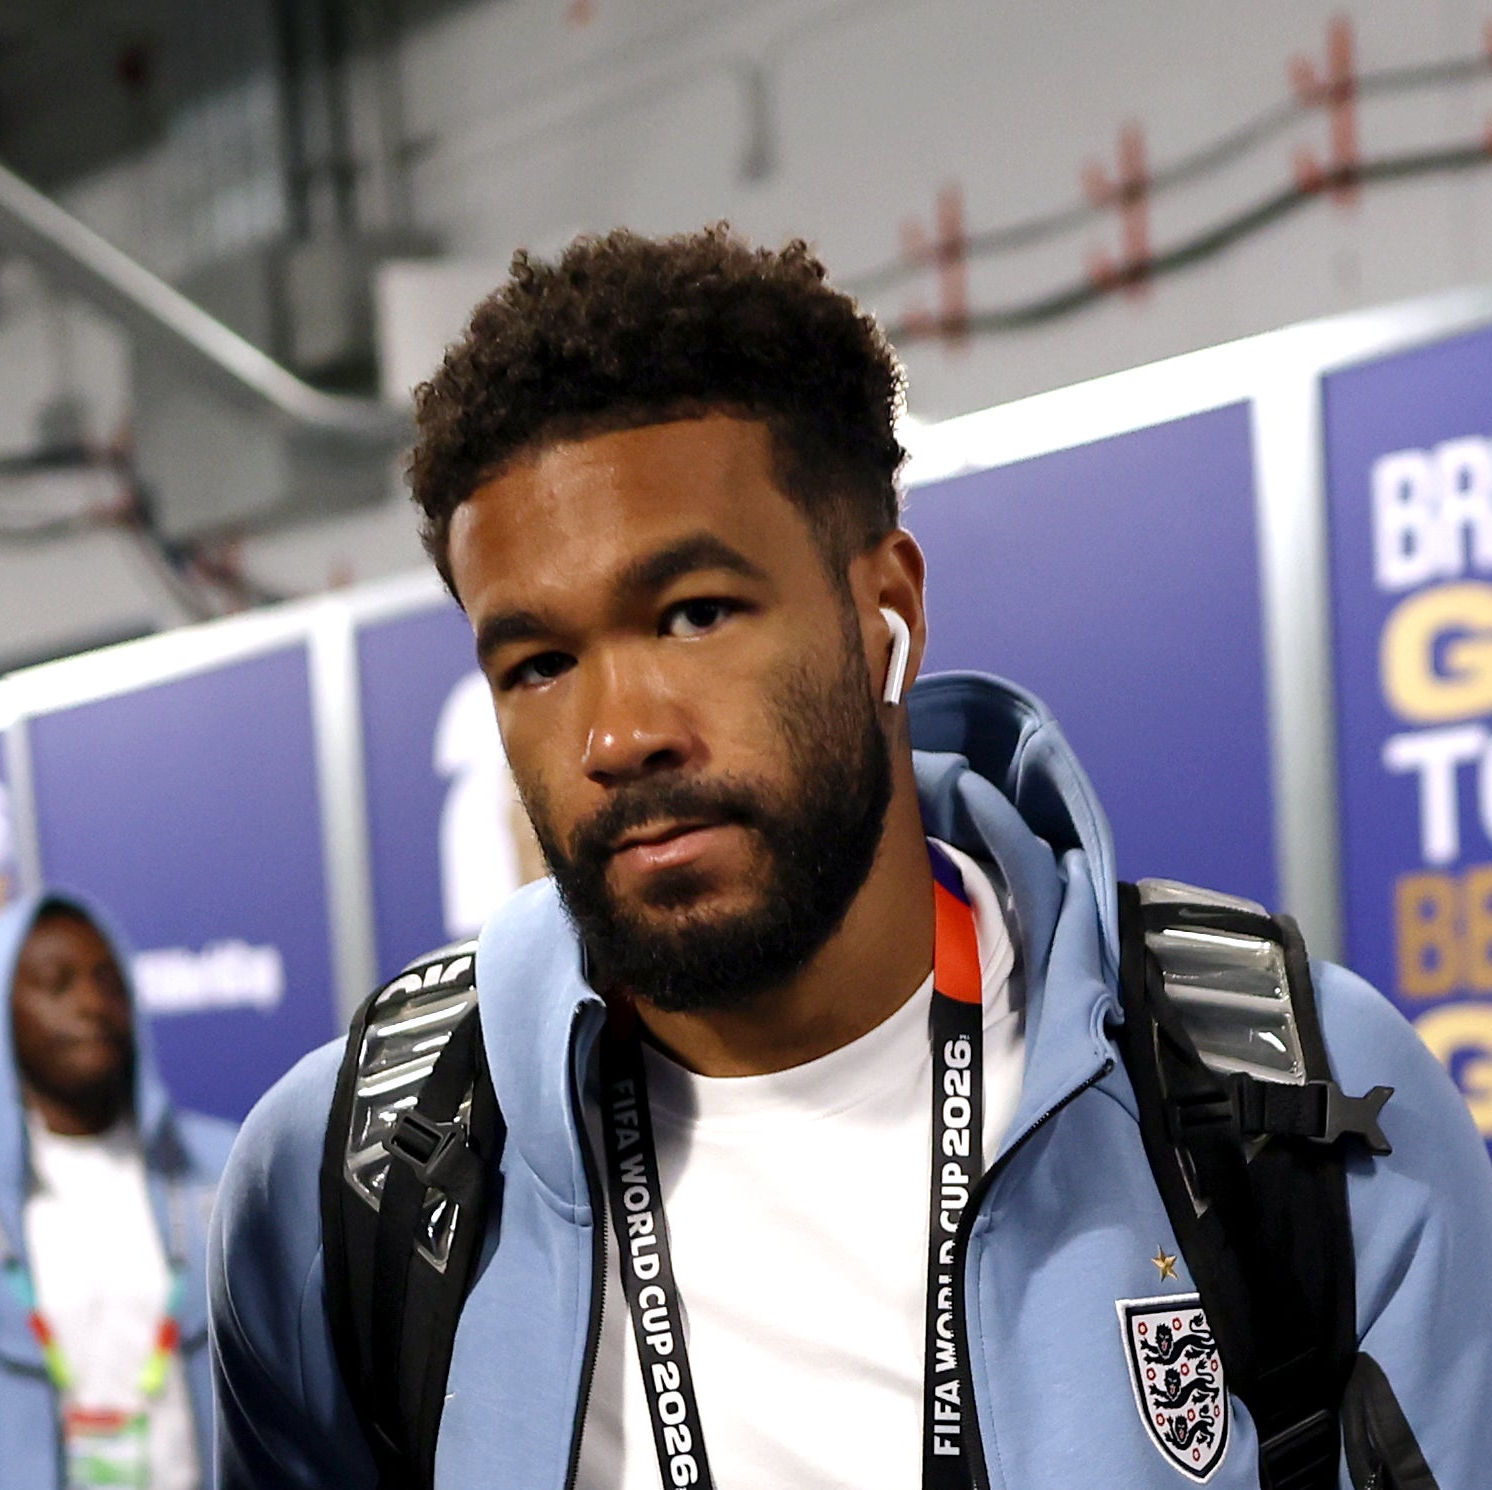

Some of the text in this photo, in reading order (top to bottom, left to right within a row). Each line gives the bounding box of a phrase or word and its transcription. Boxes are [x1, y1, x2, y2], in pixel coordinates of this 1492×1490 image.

[612, 1077, 641, 1152] FIFA
[618, 1153, 661, 1281] WORLD
[940, 1162, 970, 1233] CUP
[638, 1285, 675, 1356] CUP
[933, 1379, 961, 1456] FIFA
